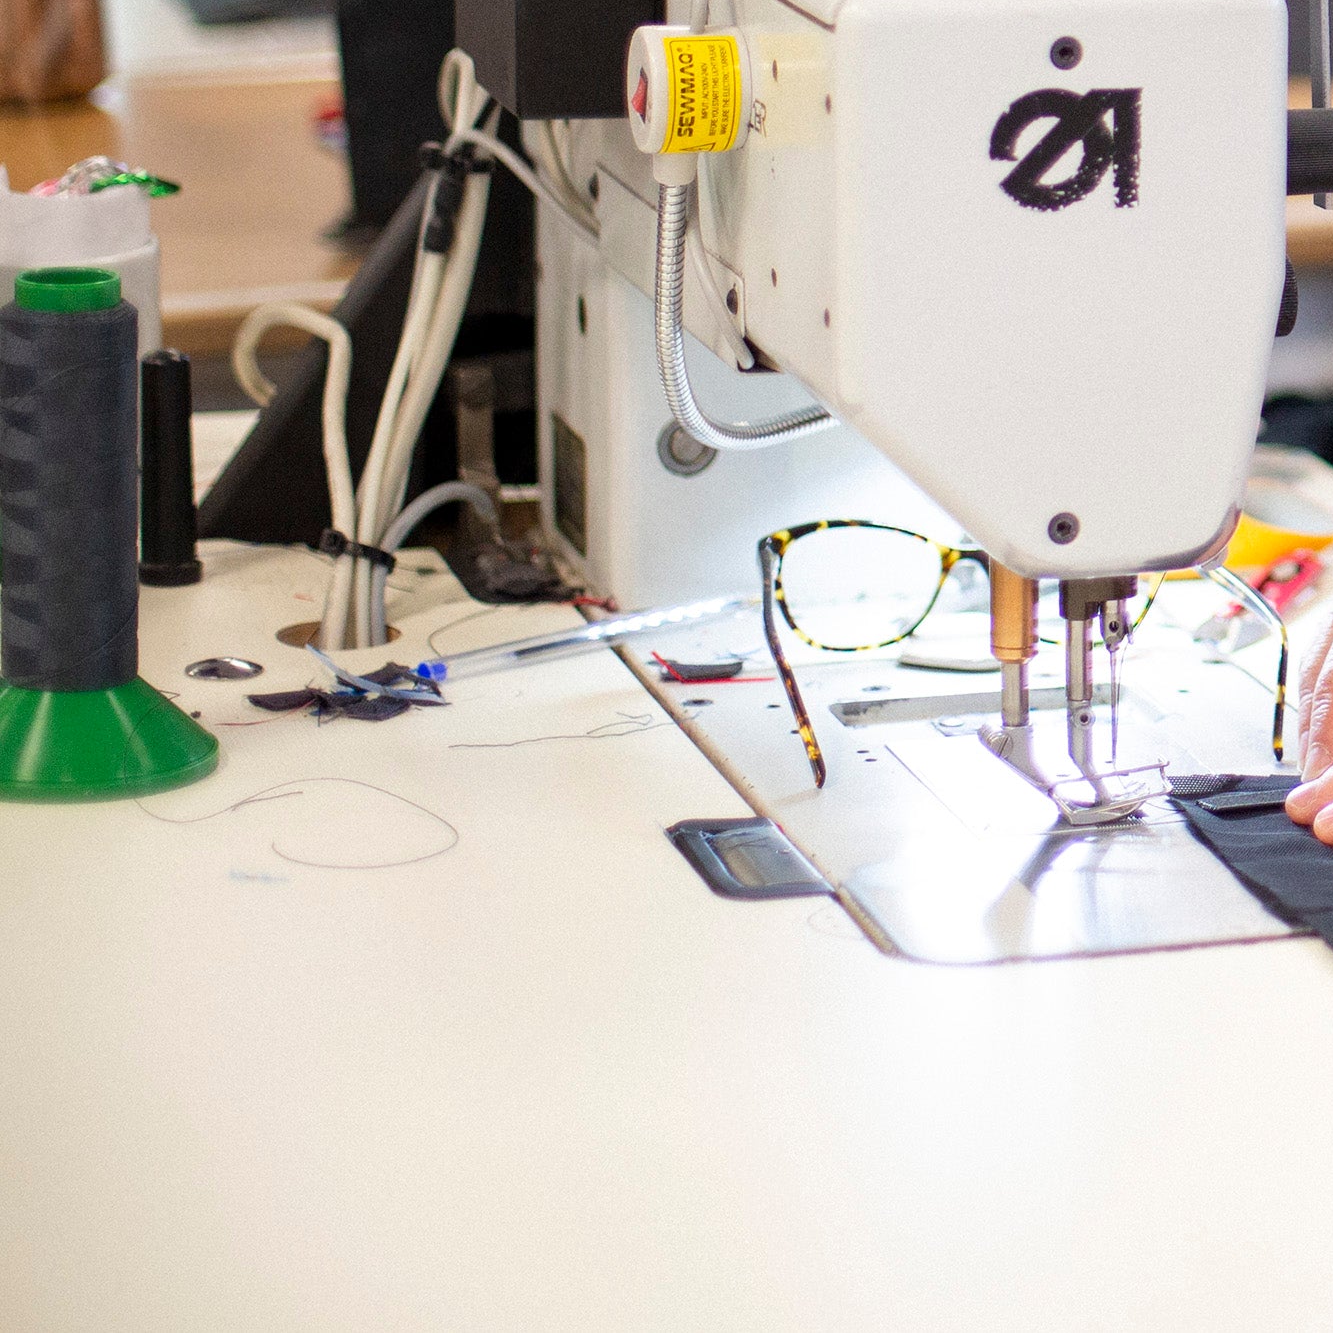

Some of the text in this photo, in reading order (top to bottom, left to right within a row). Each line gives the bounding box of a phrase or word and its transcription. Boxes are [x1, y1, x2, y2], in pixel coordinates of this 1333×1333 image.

[710, 77, 719, 89] THIS
[721, 72, 731, 97] ELECTRIC
[710, 90, 719, 107] START
[721, 97, 730, 108] THE
[710, 107, 719, 118] YOU
[720, 109, 730, 123] SURE
[708, 117, 719, 136] BEFORE
